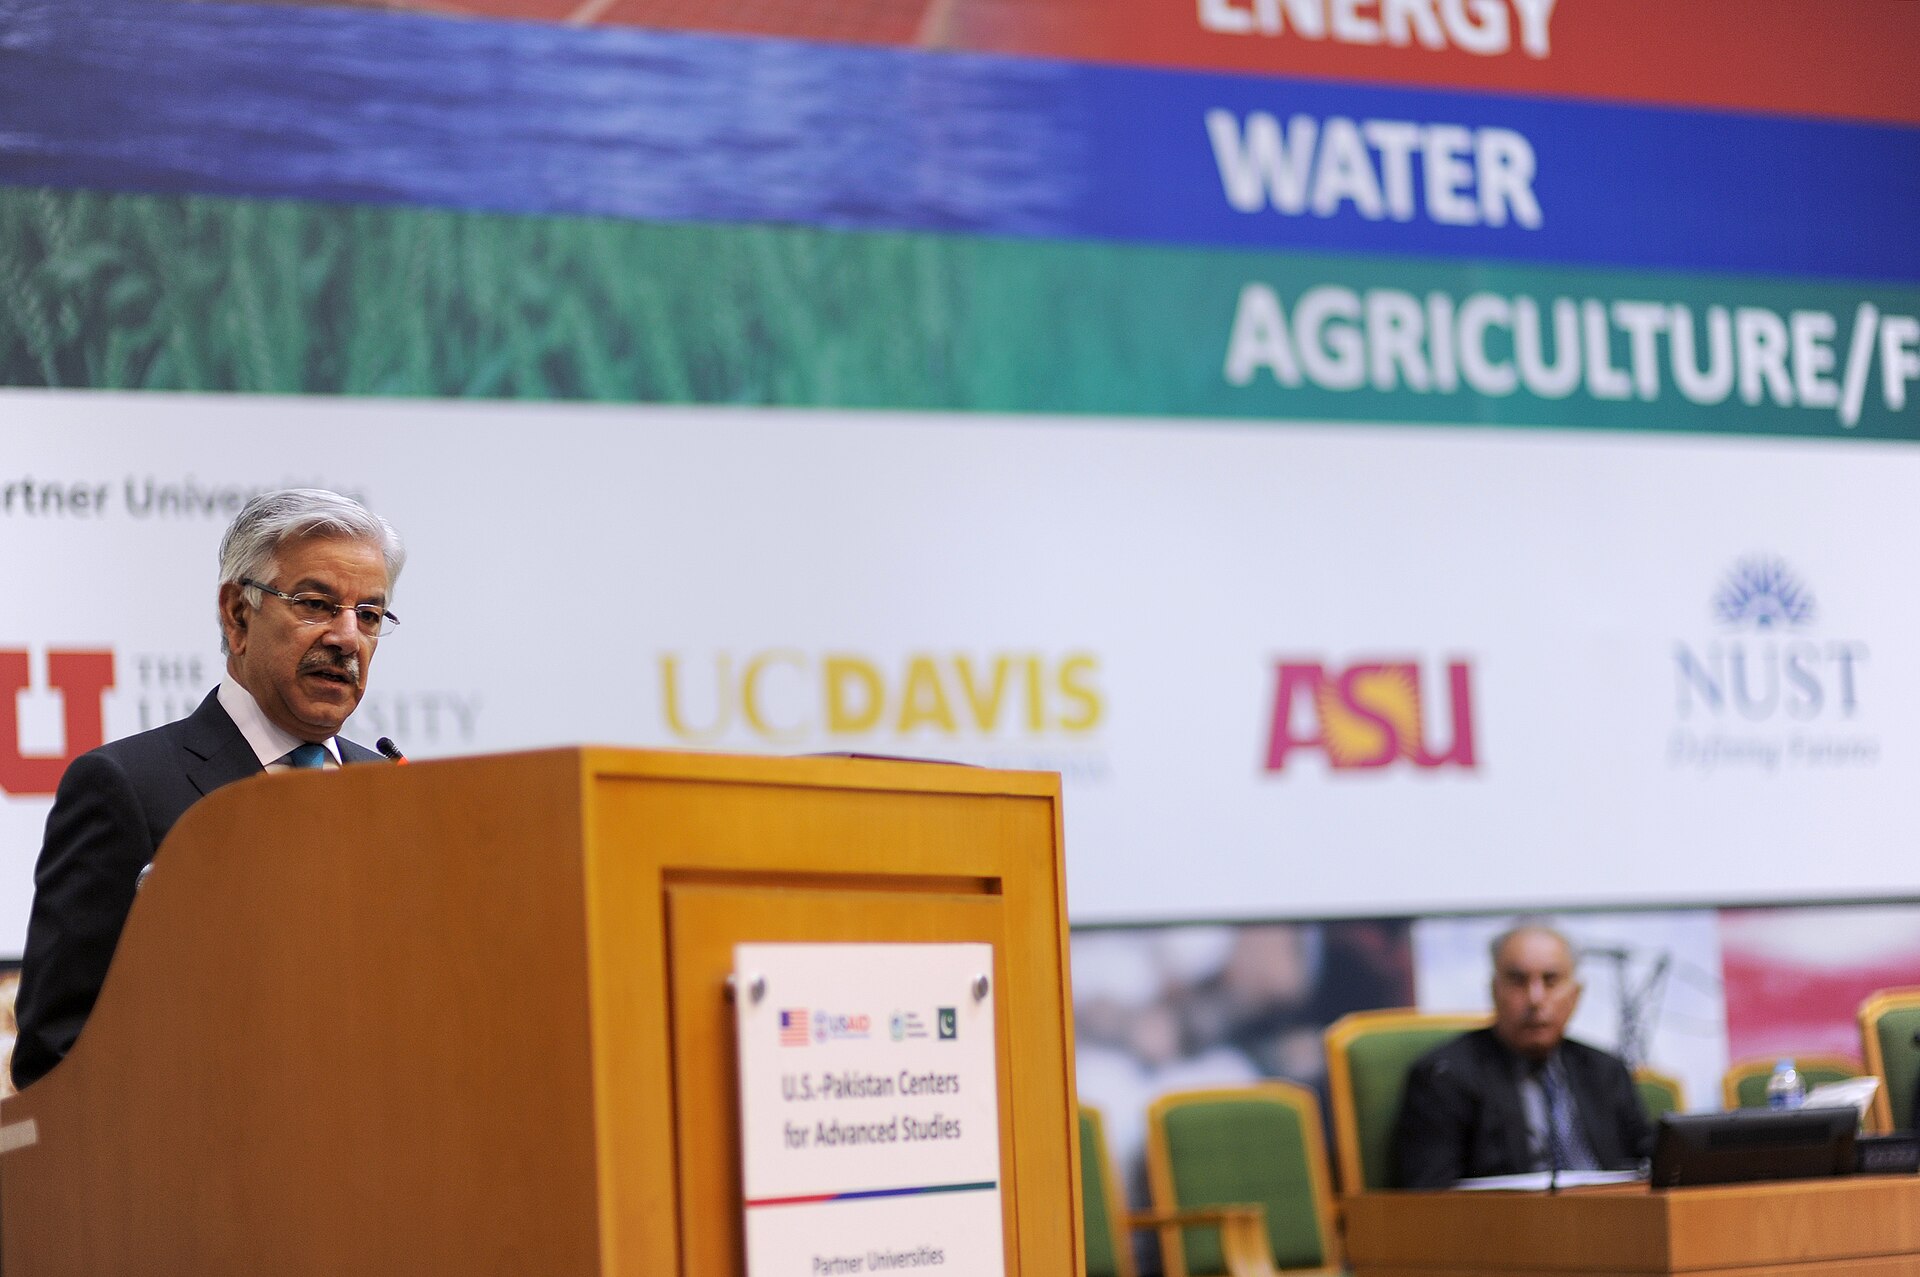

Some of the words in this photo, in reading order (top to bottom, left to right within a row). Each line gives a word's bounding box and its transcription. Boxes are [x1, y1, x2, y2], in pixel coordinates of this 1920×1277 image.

[1205, 108, 1543, 230] WATER
[1224, 282, 1920, 428] AGRICULTURE/F
[134, 654, 203, 687] THE
[1671, 640, 1871, 722] NUST
[1262, 657, 1479, 775] ASU
[781, 1070, 895, 1101] U.S.-Pakistan
[898, 1069, 960, 1096] Centers
[783, 1119, 809, 1149] for
[814, 1115, 898, 1145] Advanced
[902, 1112, 961, 1142] Studies
[812, 1253, 864, 1277] Partner
[866, 1243, 945, 1272] Universities
